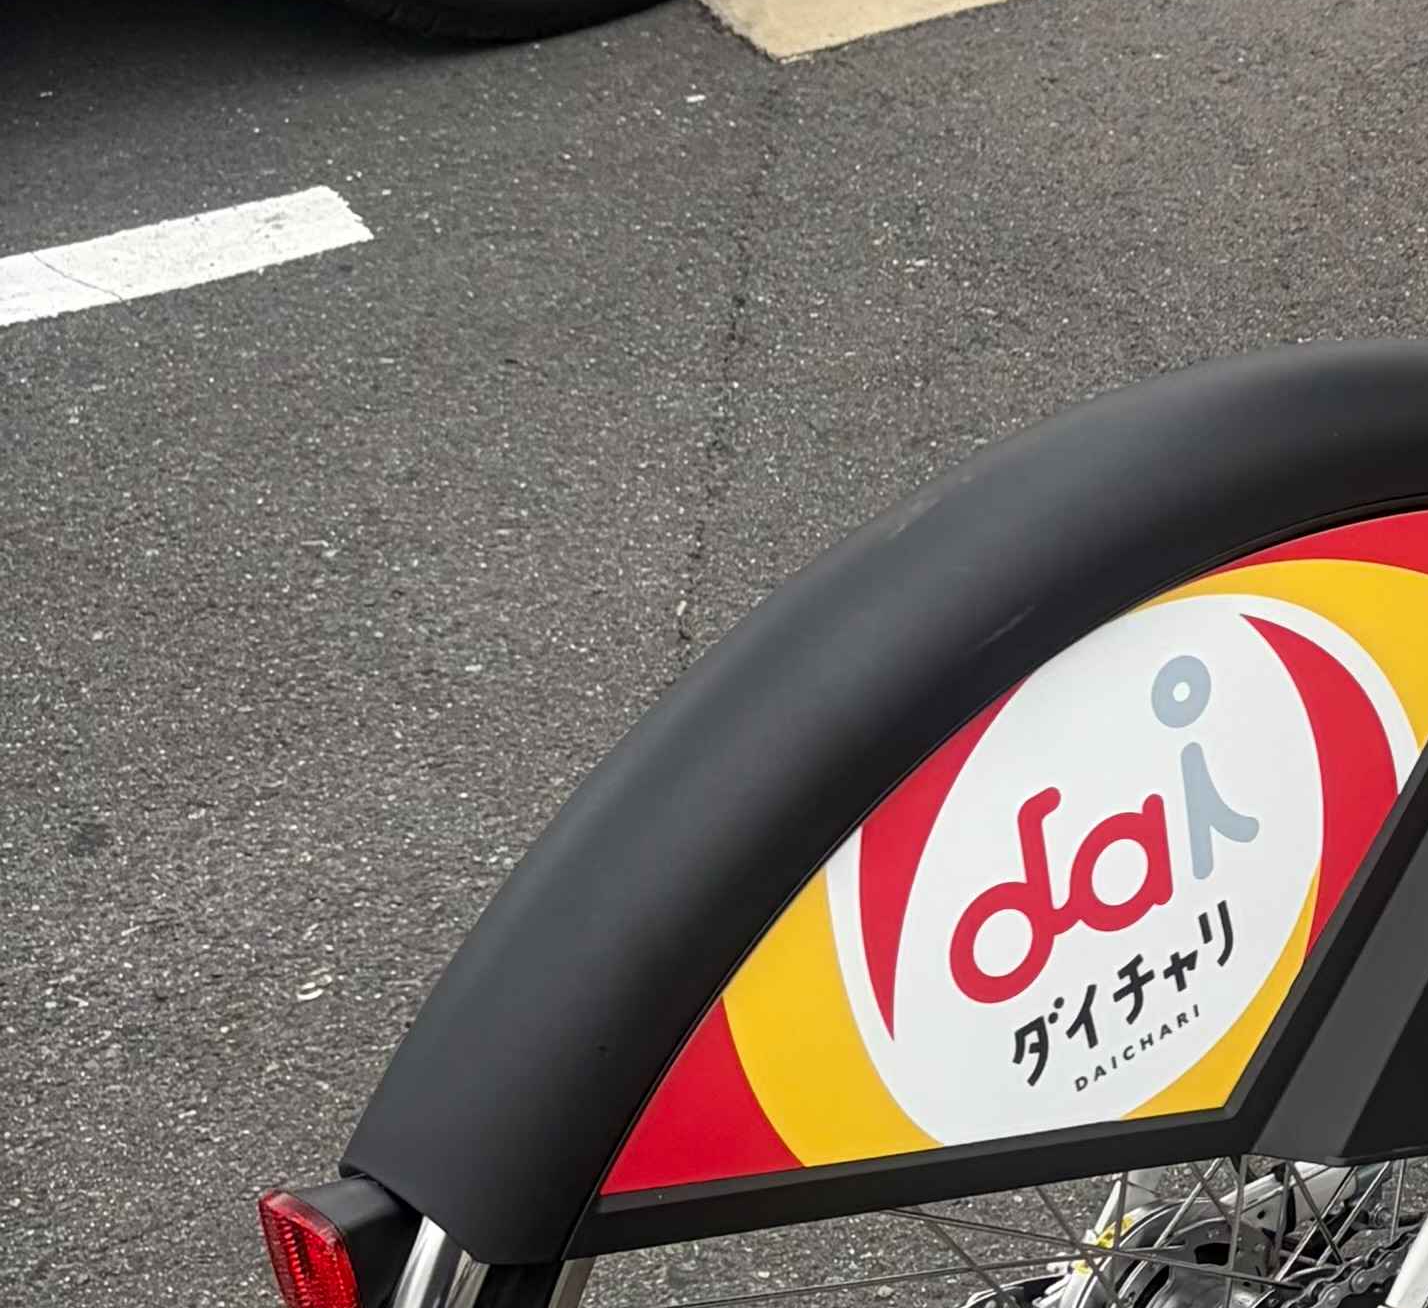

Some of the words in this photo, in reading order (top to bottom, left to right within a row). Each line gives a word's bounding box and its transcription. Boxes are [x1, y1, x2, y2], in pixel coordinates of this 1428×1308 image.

[1011, 900, 1236, 1087] ダイチャリ
[1075, 1003, 1201, 1092] DAICHARI
